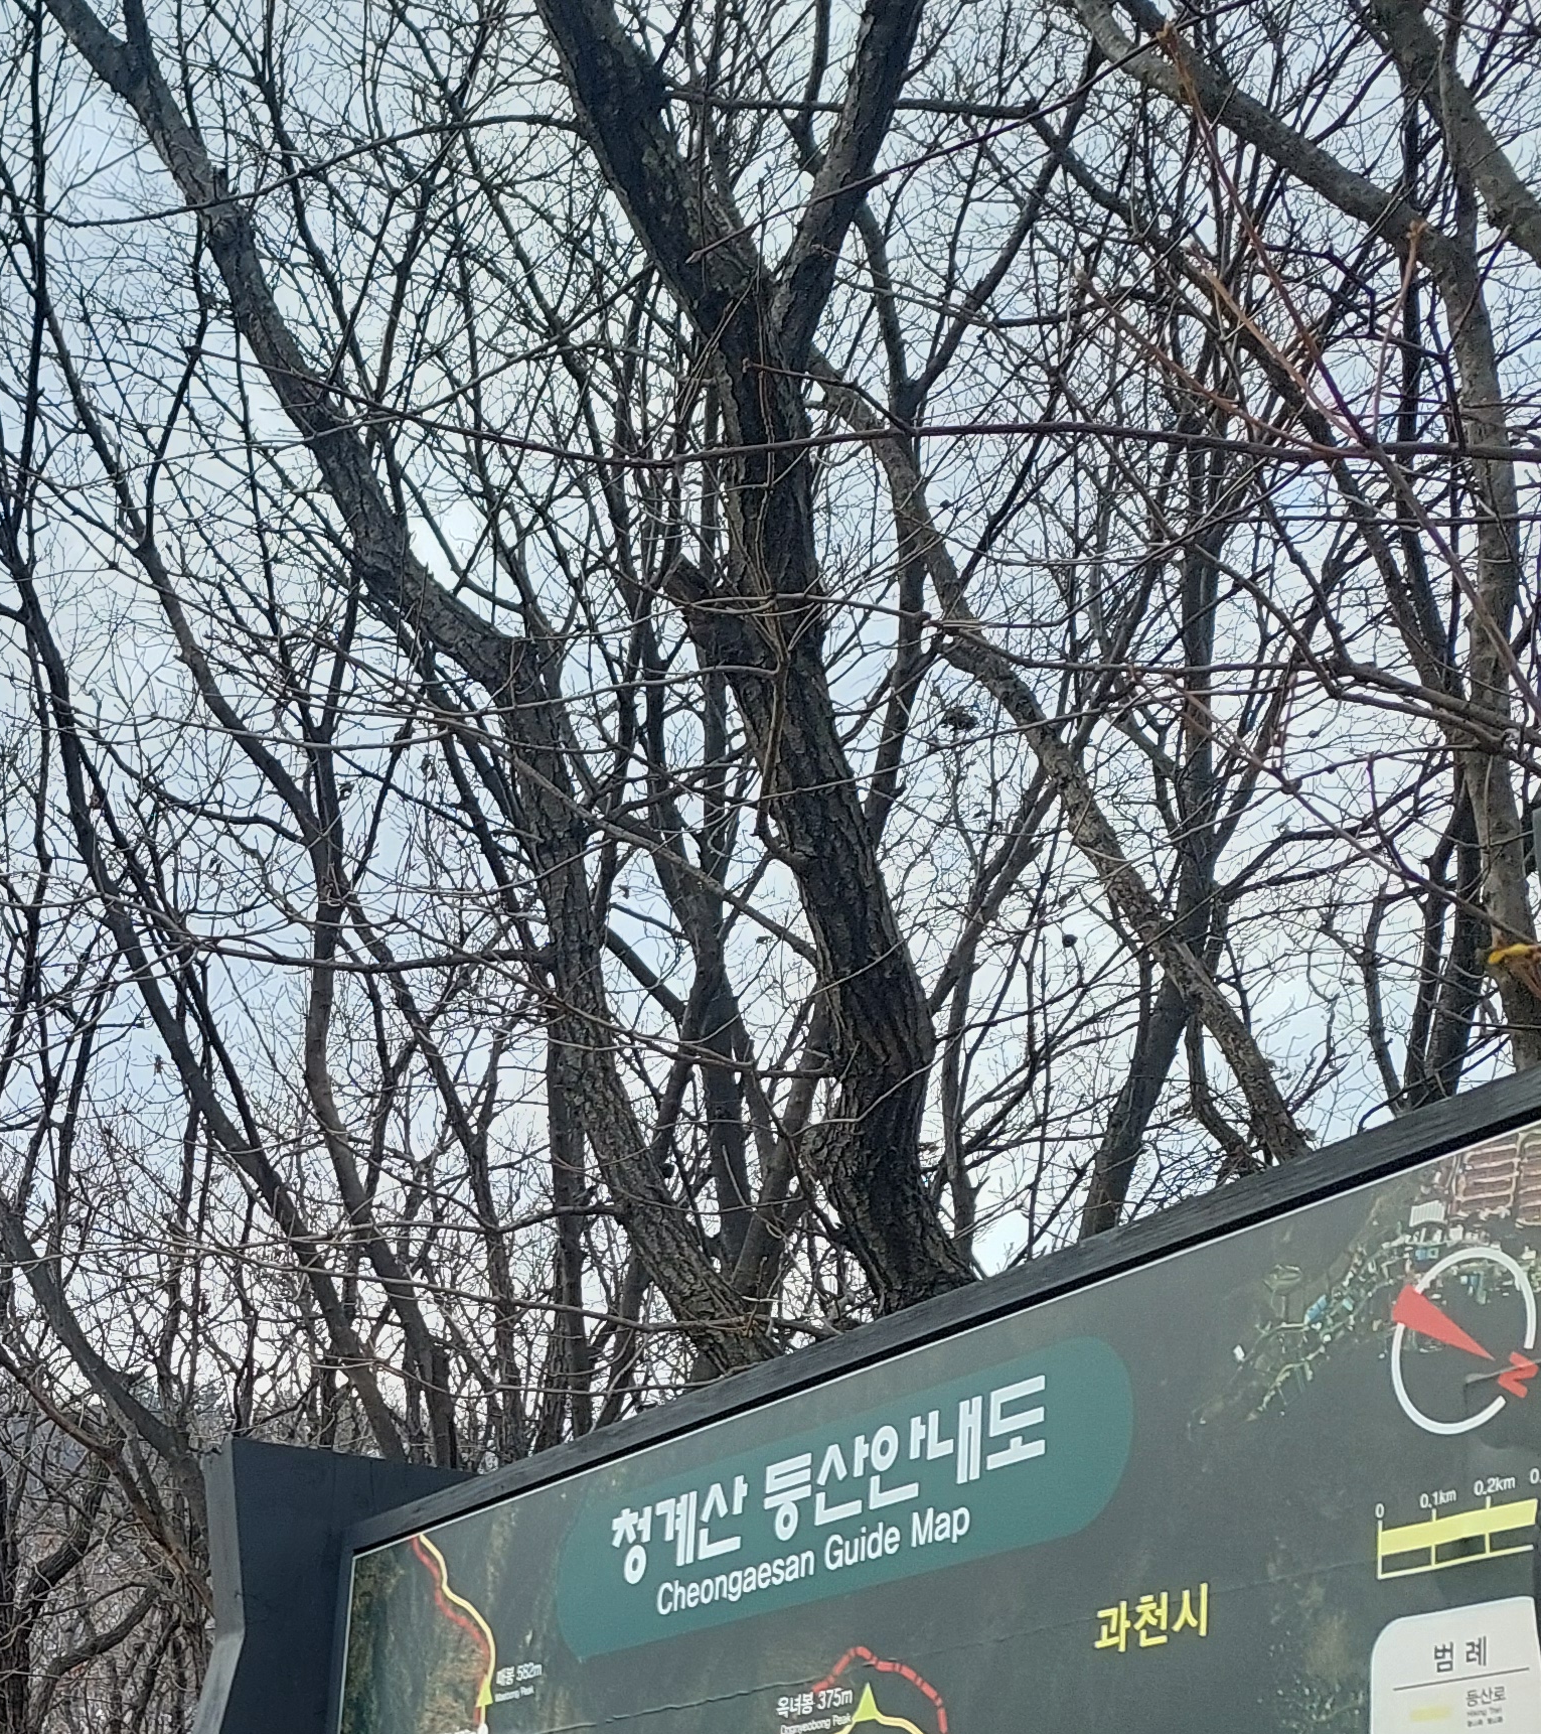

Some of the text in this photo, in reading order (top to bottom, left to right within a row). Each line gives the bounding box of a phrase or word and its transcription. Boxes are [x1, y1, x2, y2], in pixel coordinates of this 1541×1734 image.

[611, 1375, 1046, 1584] 청계산 등산안내도
[1375, 1503, 1384, 1518] 0
[1420, 1490, 1457, 1508] 0.1km
[1474, 1477, 1516, 1496] 0.2km
[656, 1506, 970, 1616] Cheongaesan Guide Map
[1094, 1582, 1208, 1652] 과천시
[776, 1688, 853, 1718] 옥녀봉 375m
[1465, 1686, 1506, 1707] 등산로
